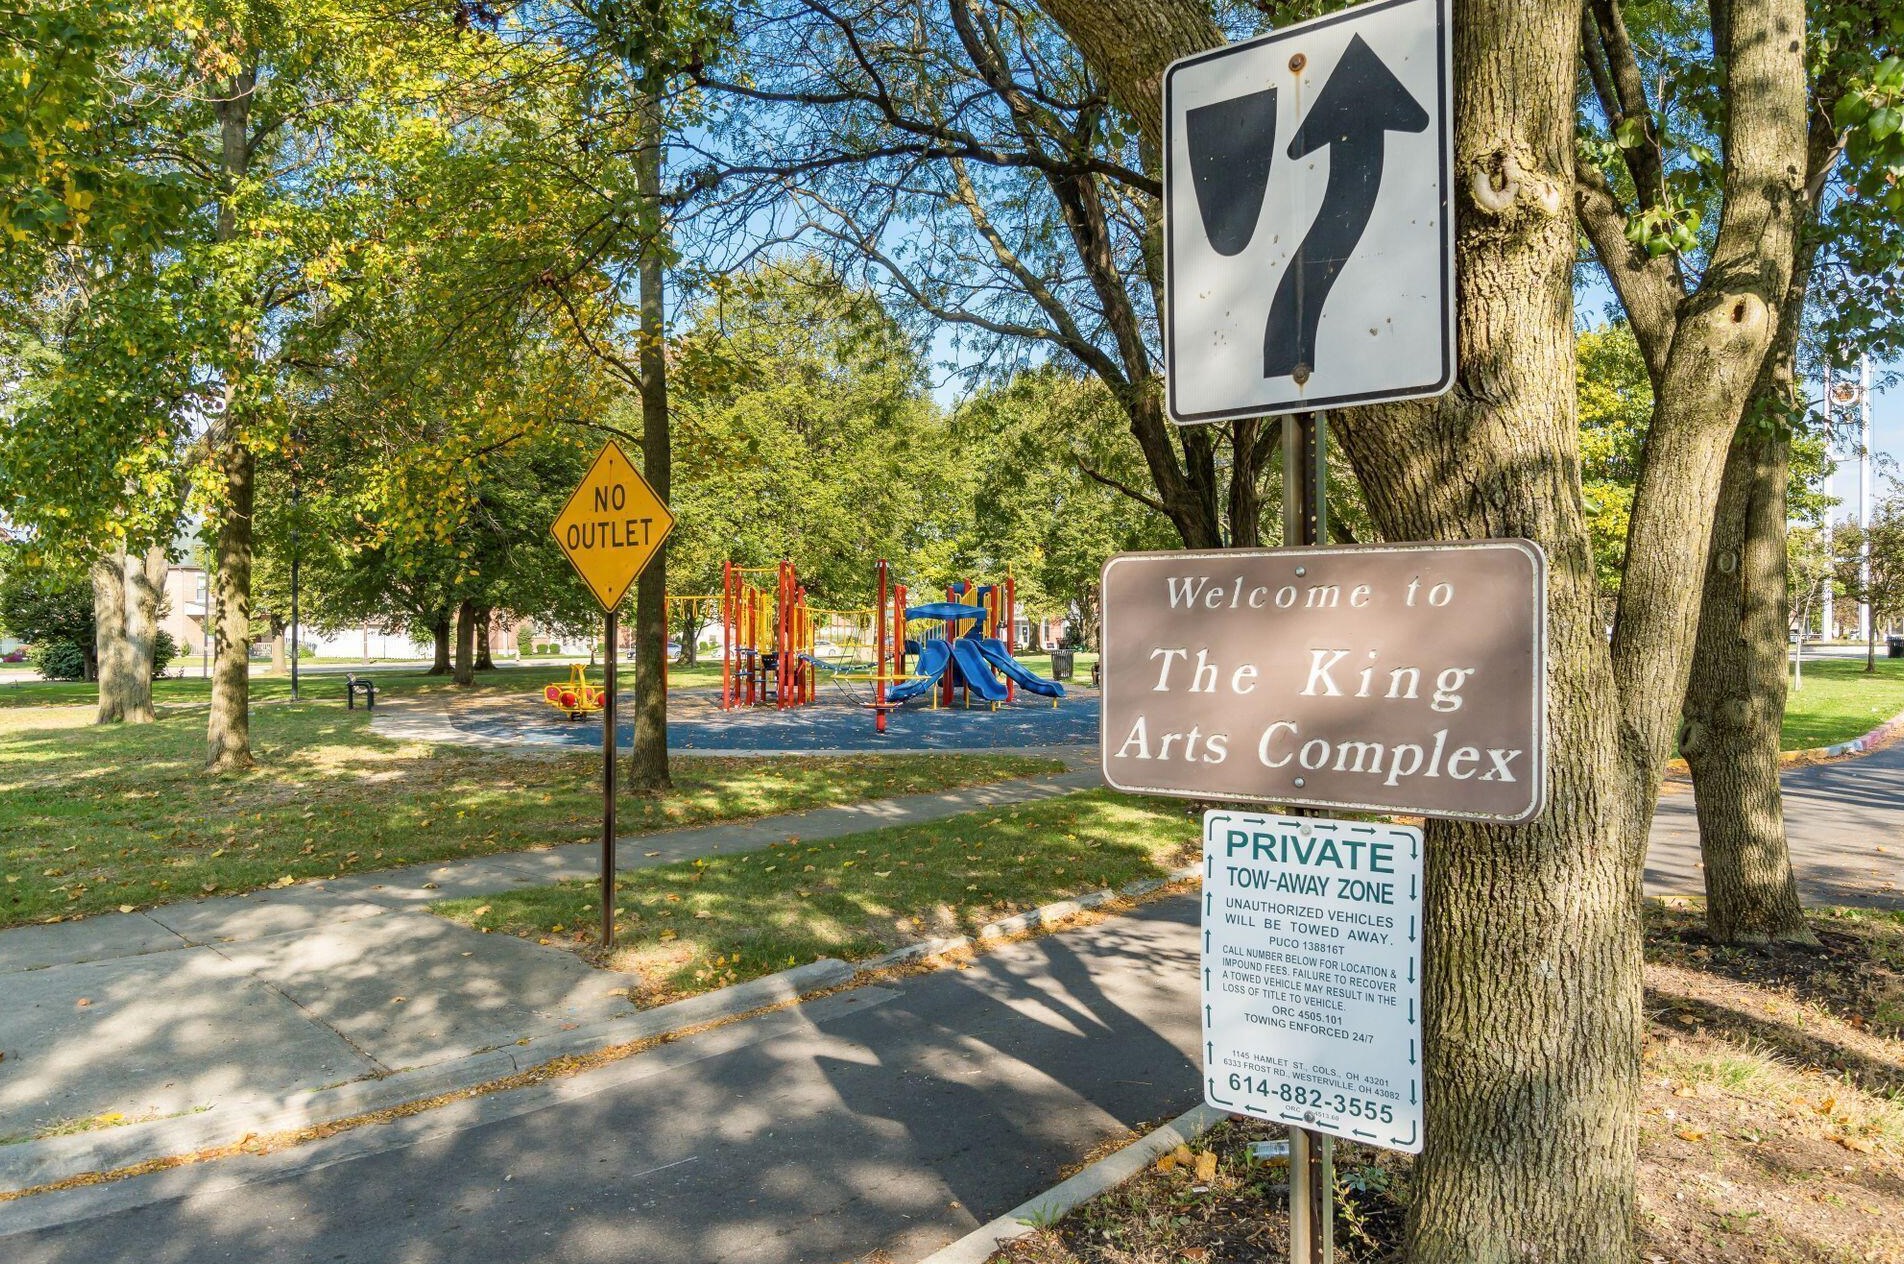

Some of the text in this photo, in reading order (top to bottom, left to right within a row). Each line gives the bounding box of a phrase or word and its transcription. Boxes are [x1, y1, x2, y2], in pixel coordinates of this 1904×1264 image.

[594, 483, 626, 512] NO
[567, 518, 653, 550] OUTLET
[1167, 576, 1454, 609] Welcome to
[1149, 647, 1475, 712] The King
[1114, 715, 1523, 786] Arts Complex
[1226, 830, 1394, 874] PRIVATE
[1226, 865, 1393, 904] TOW-AWAY ZONE
[1225, 912, 1392, 945] WILL BE TOWED AWAY.
[1226, 896, 1393, 928] UNAUTHORIZED VEHICLES
[1222, 944, 1396, 979] CALL NUMBER BELOW FOR LOCATION &
[1269, 935, 1344, 955] PUCO 138816T
[1222, 957, 1396, 992] IMPOUND FEES. FAILURE TO RECOVER
[1222, 969, 1396, 1006] A TOWED VEHICLE MAY RESULT IN THE
[1222, 982, 1345, 1011] LOSS OF TITLE TO VEHICLE.
[1243, 1012, 1373, 1043] TOWING ENFORCED 24/7
[1271, 1005, 1341, 1025] ORC 4505.101
[1223, 1057, 1242, 1068] 6333
[1243, 1061, 1271, 1073] FROST
[1358, 1084, 1371, 1094] OH
[1374, 1088, 1399, 1100] 43082
[1232, 1049, 1249, 1059] 1145
[1253, 1054, 1288, 1066] HAMLET
[1345, 1071, 1359, 1081] OH
[1363, 1075, 1388, 1087] 43201
[1228, 1072, 1392, 1123] 614-882-3555
